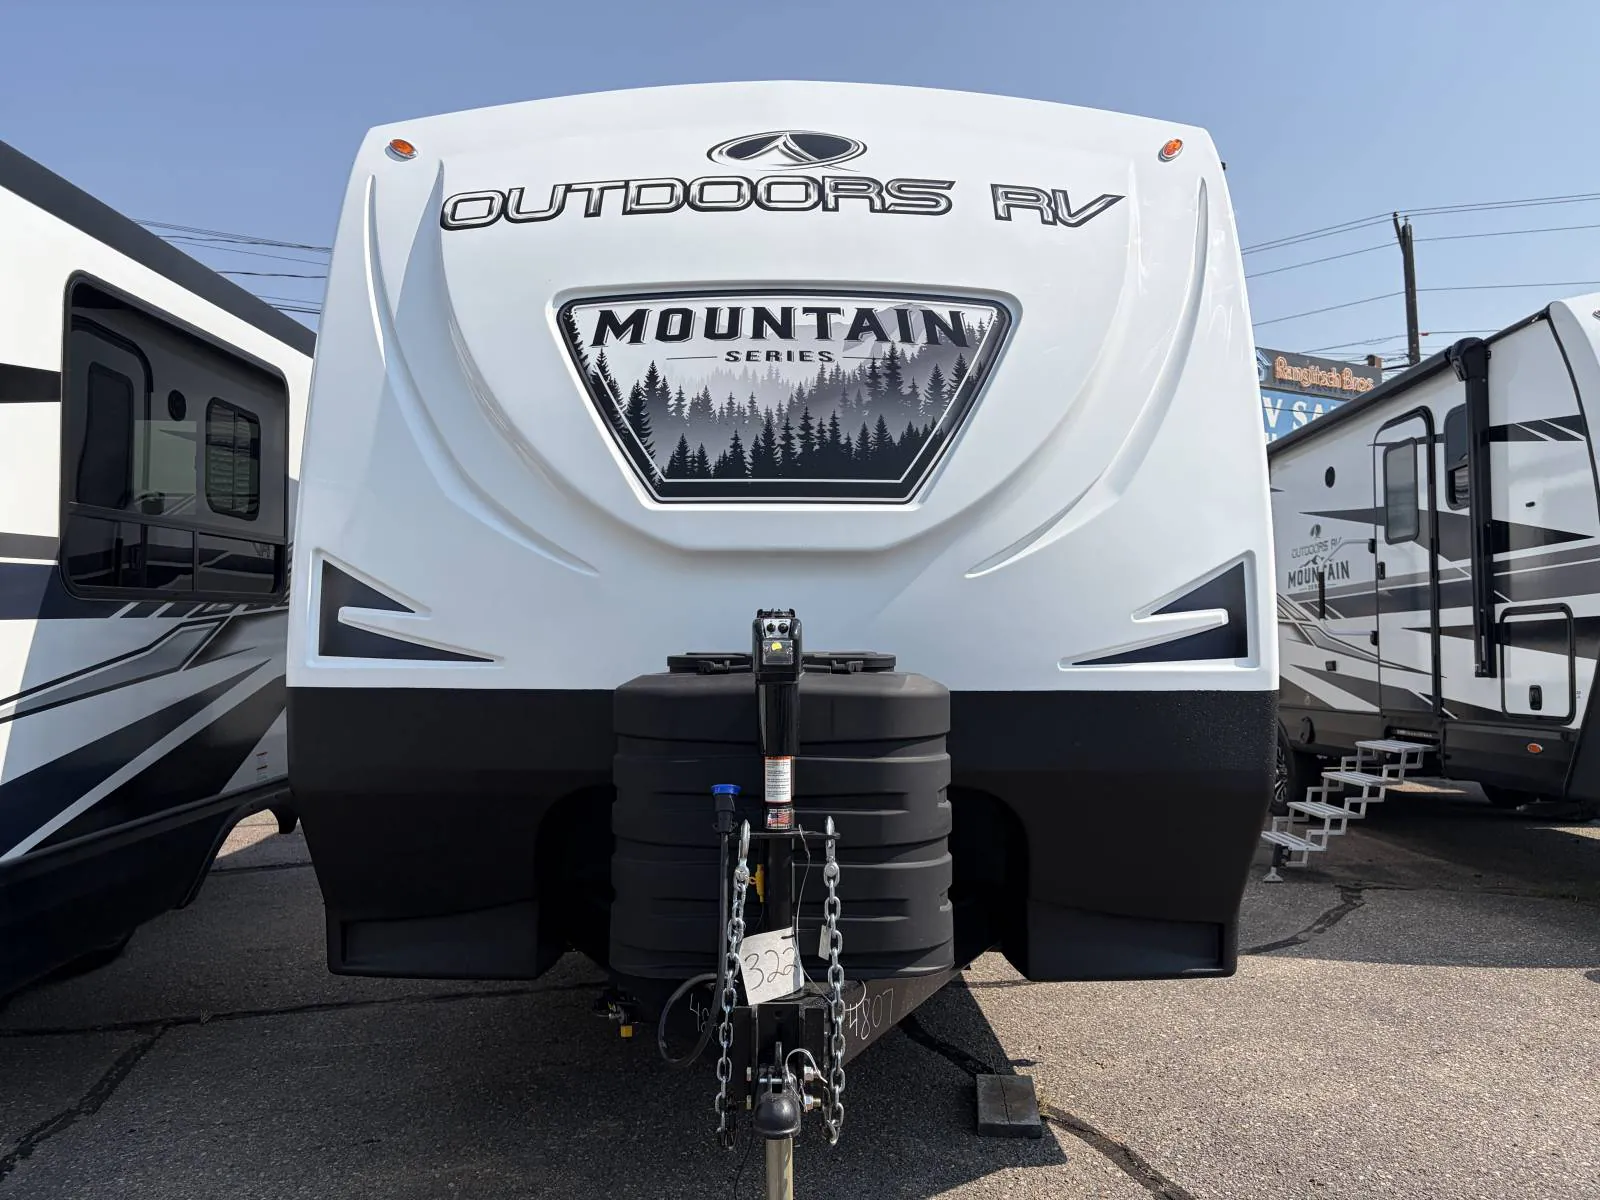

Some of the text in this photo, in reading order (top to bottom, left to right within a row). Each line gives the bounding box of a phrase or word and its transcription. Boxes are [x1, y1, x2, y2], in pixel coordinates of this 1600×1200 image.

[440, 175, 1126, 231] OUTDOORS RV
[590, 306, 971, 347] MOUNTAIN
[724, 350, 834, 363] SERIES
[1262, 396, 1283, 428] V
[744, 947, 796, 991] 322
[849, 988, 894, 1040] 4807
